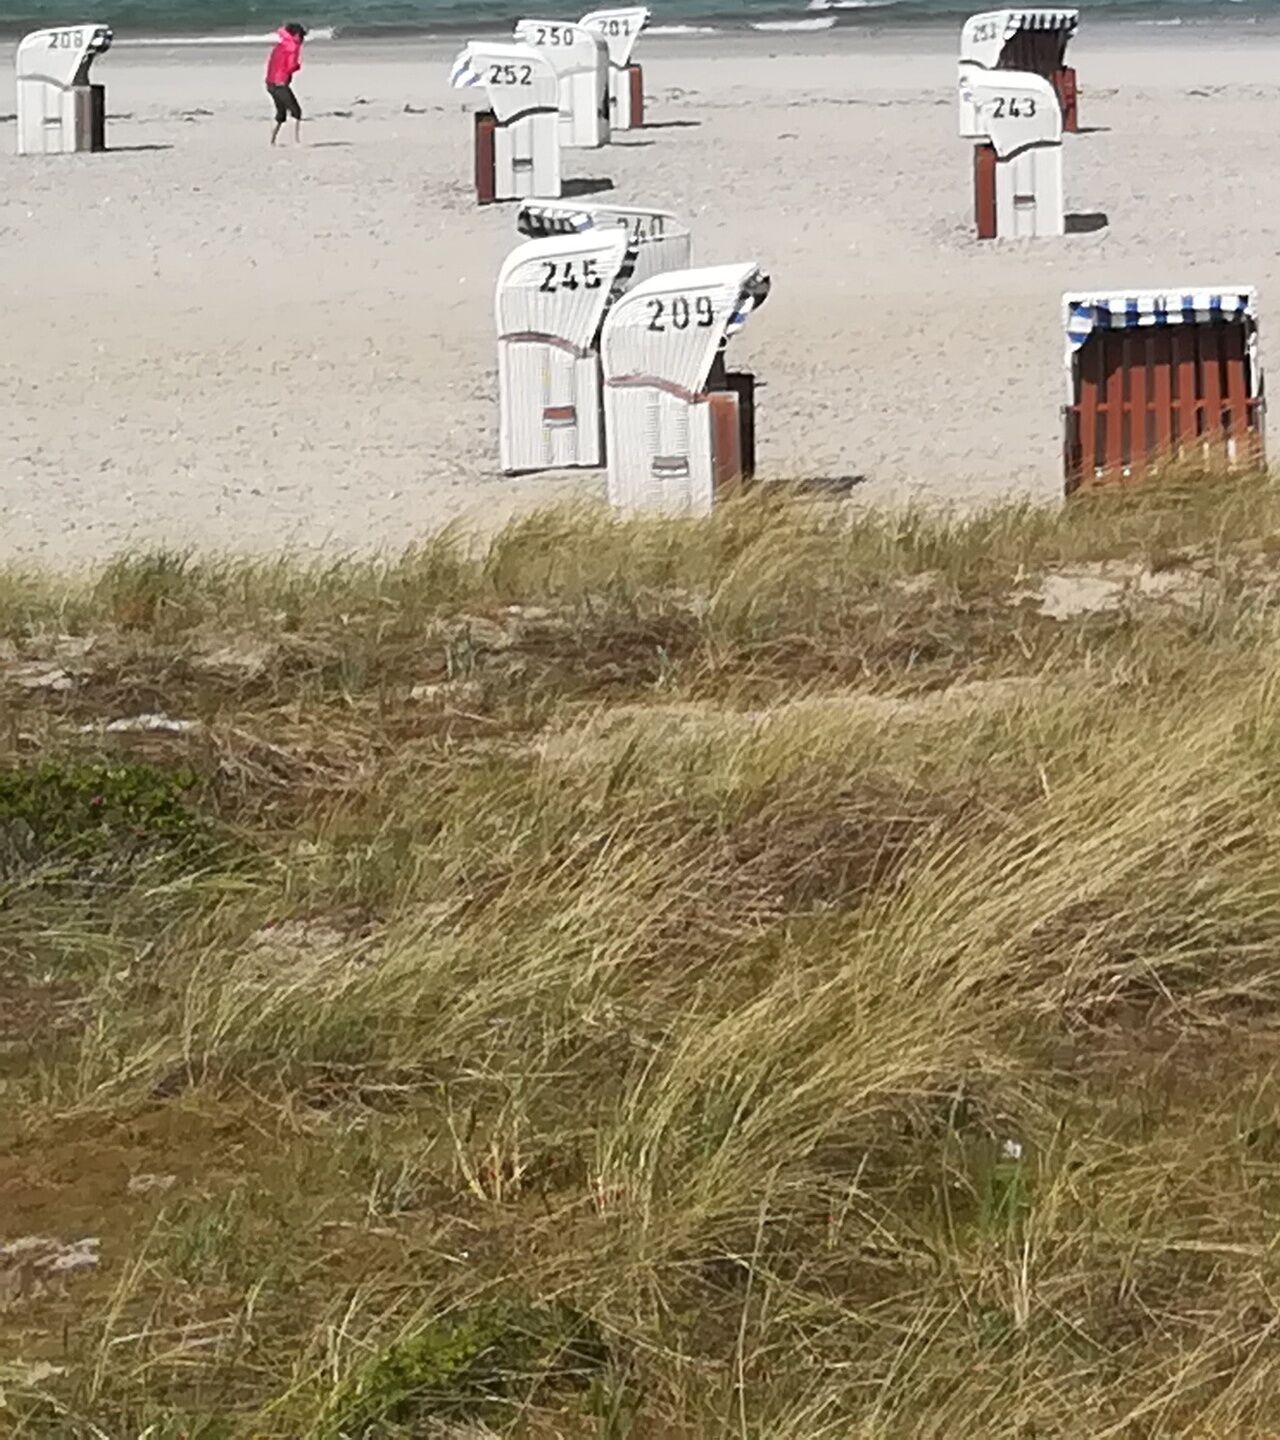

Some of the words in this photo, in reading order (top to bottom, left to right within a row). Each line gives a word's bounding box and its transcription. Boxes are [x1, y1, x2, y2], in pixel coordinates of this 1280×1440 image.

[47, 30, 84, 49] 208
[535, 27, 575, 47] 250
[488, 64, 533, 86] 252
[991, 96, 1037, 119] 243
[539, 258, 602, 293] 245
[647, 296, 716, 332] 209
